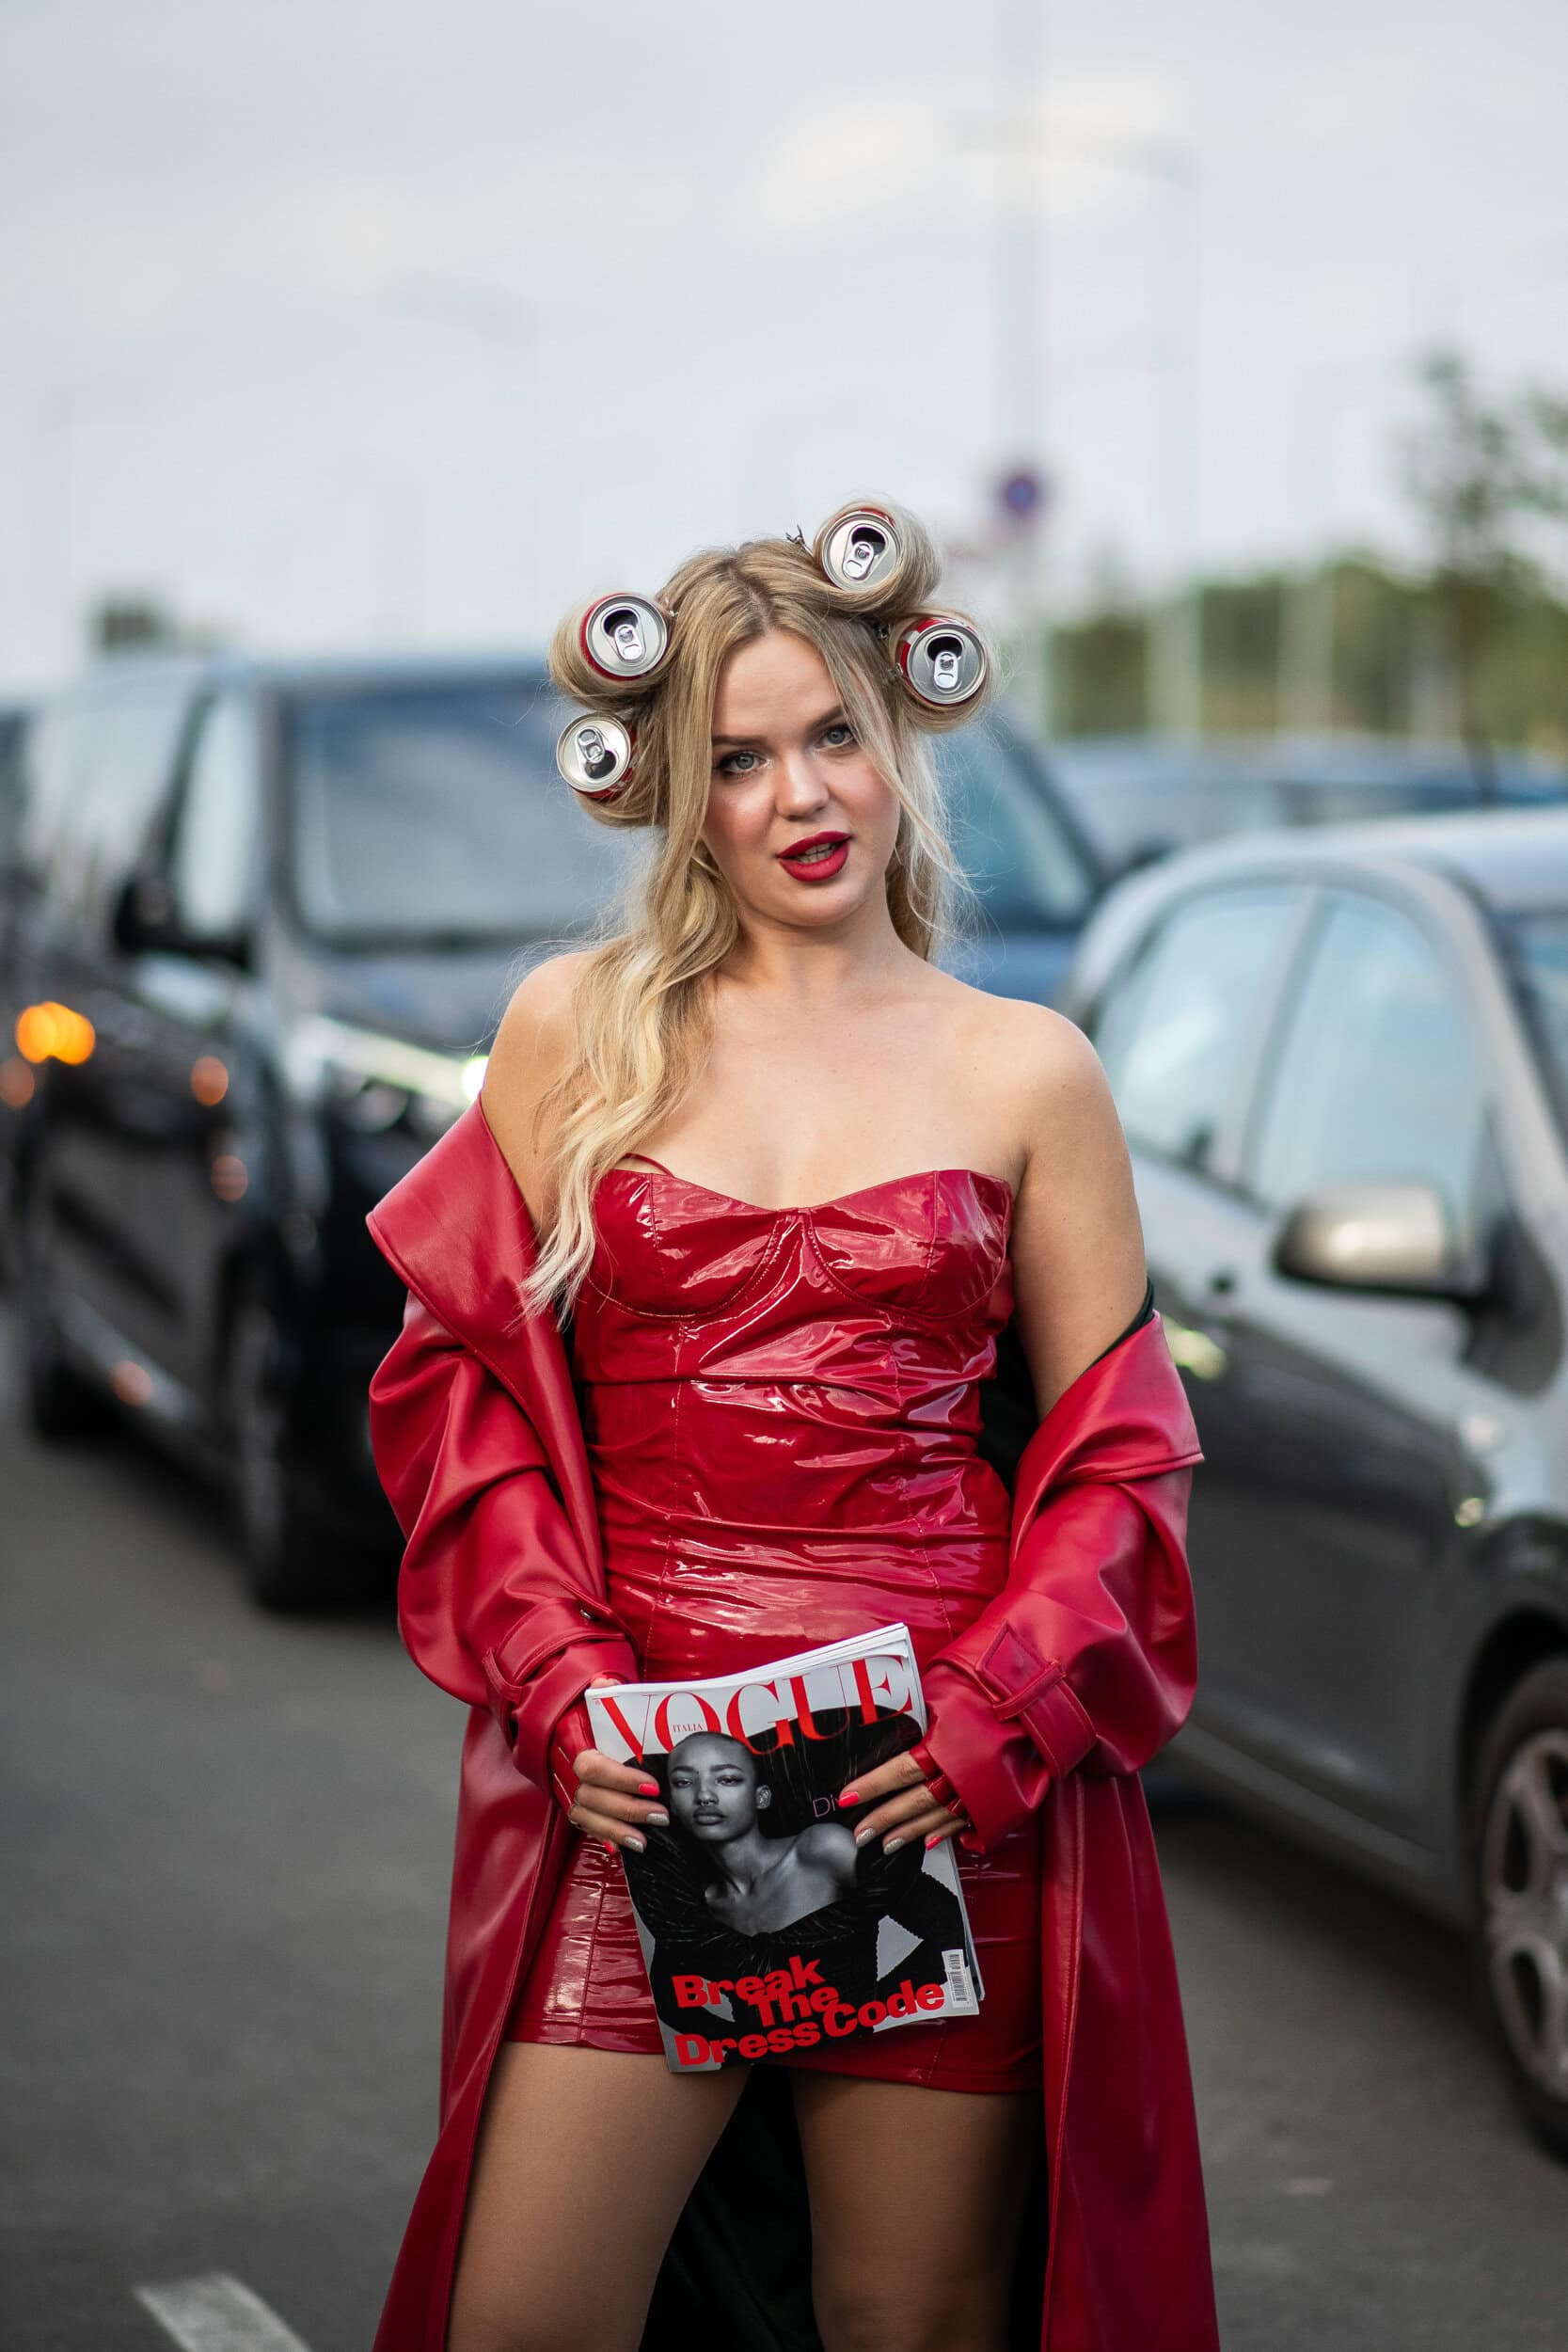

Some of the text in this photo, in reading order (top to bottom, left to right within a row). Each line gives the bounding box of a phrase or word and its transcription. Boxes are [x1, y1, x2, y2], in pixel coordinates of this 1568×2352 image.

[592, 1656, 913, 1764] VOGUE
[673, 1723, 704, 1733] ITALIA
[672, 1955, 826, 2009] Break
[749, 1986, 840, 2026] The
